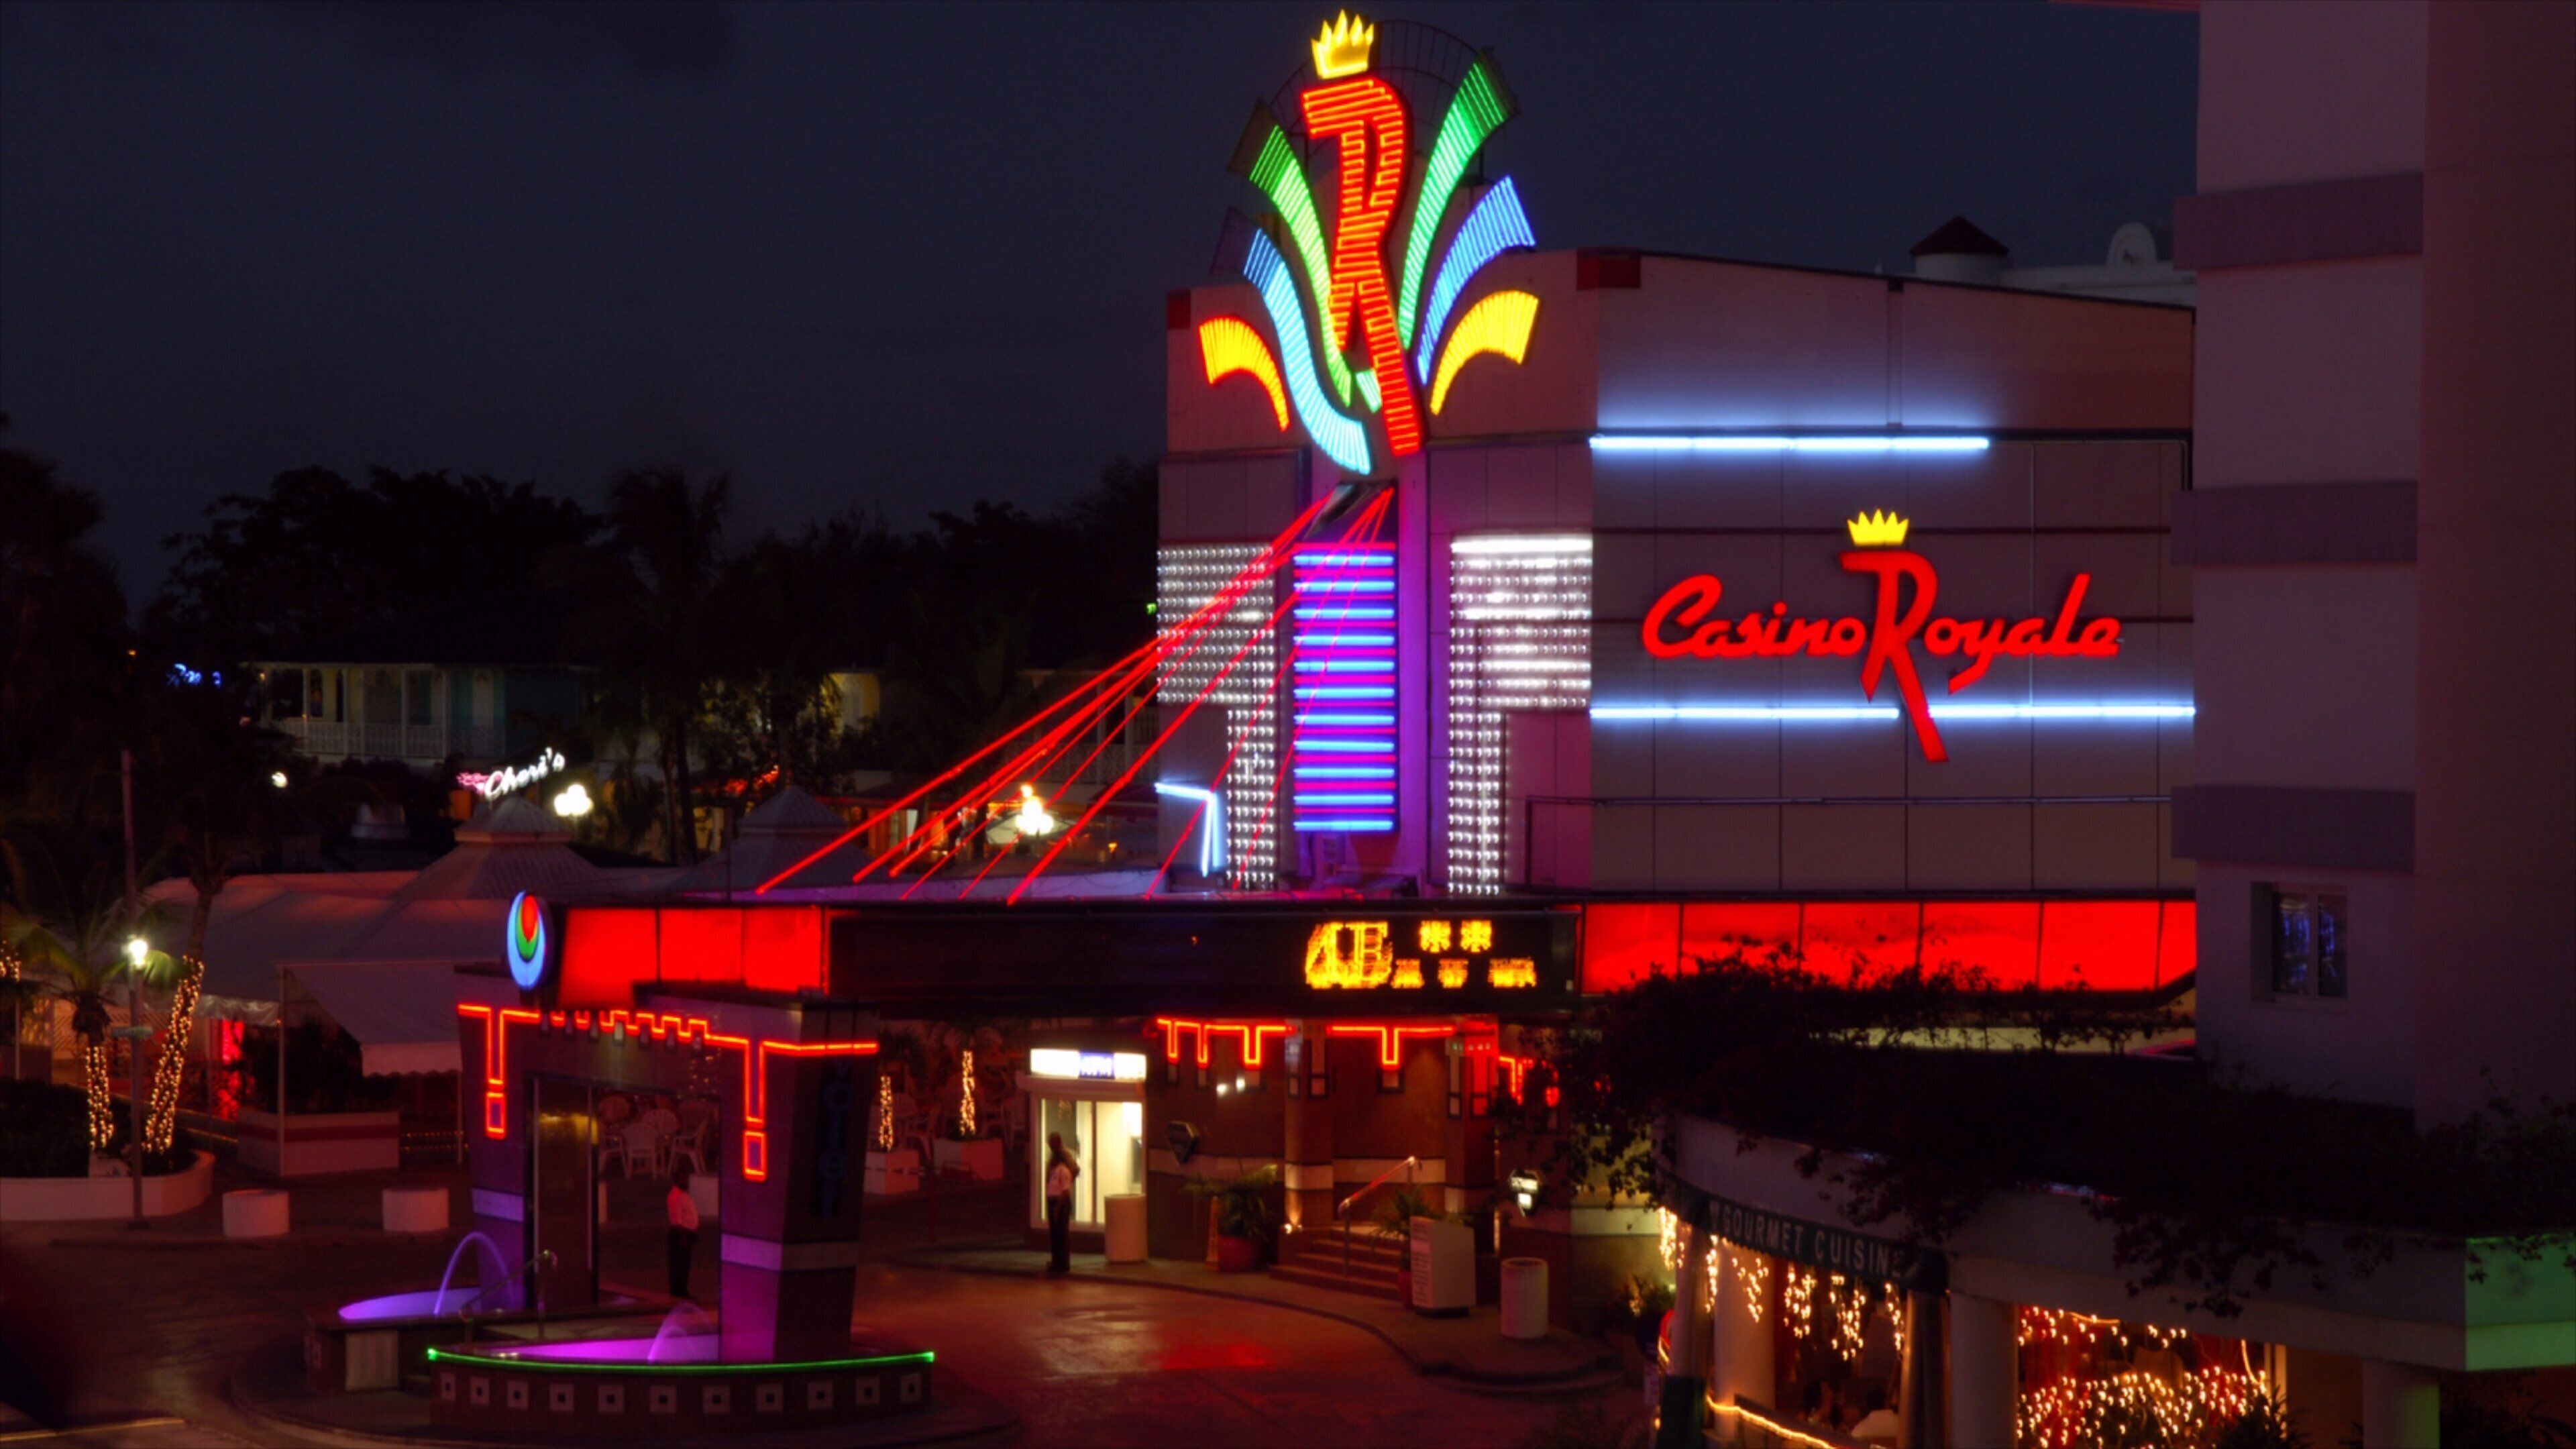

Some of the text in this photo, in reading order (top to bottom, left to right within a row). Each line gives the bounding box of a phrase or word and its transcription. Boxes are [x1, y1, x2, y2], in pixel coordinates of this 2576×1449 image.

[1642, 550, 2121, 762] Casino Royale
[484, 747, 566, 800] Cheri's
[1722, 1204, 1805, 1255] GOURMET
